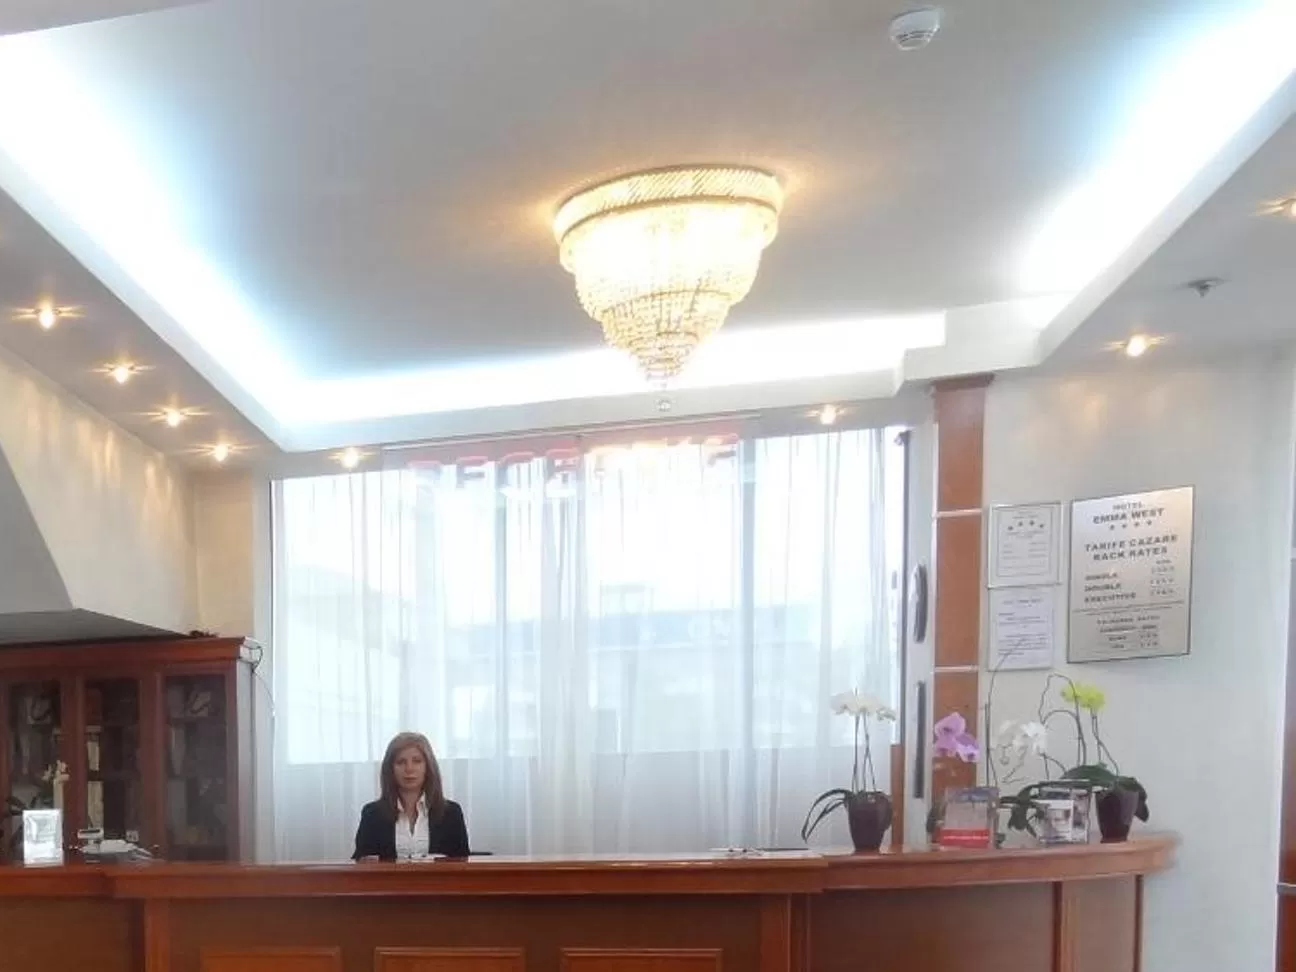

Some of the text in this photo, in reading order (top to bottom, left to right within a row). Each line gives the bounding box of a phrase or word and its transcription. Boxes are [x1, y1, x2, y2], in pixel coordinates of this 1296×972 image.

[1092, 507, 1165, 524] EMMA WEST
[1084, 533, 1178, 552] TARIFE CAZARE
[1093, 546, 1168, 561] RACK RATES
